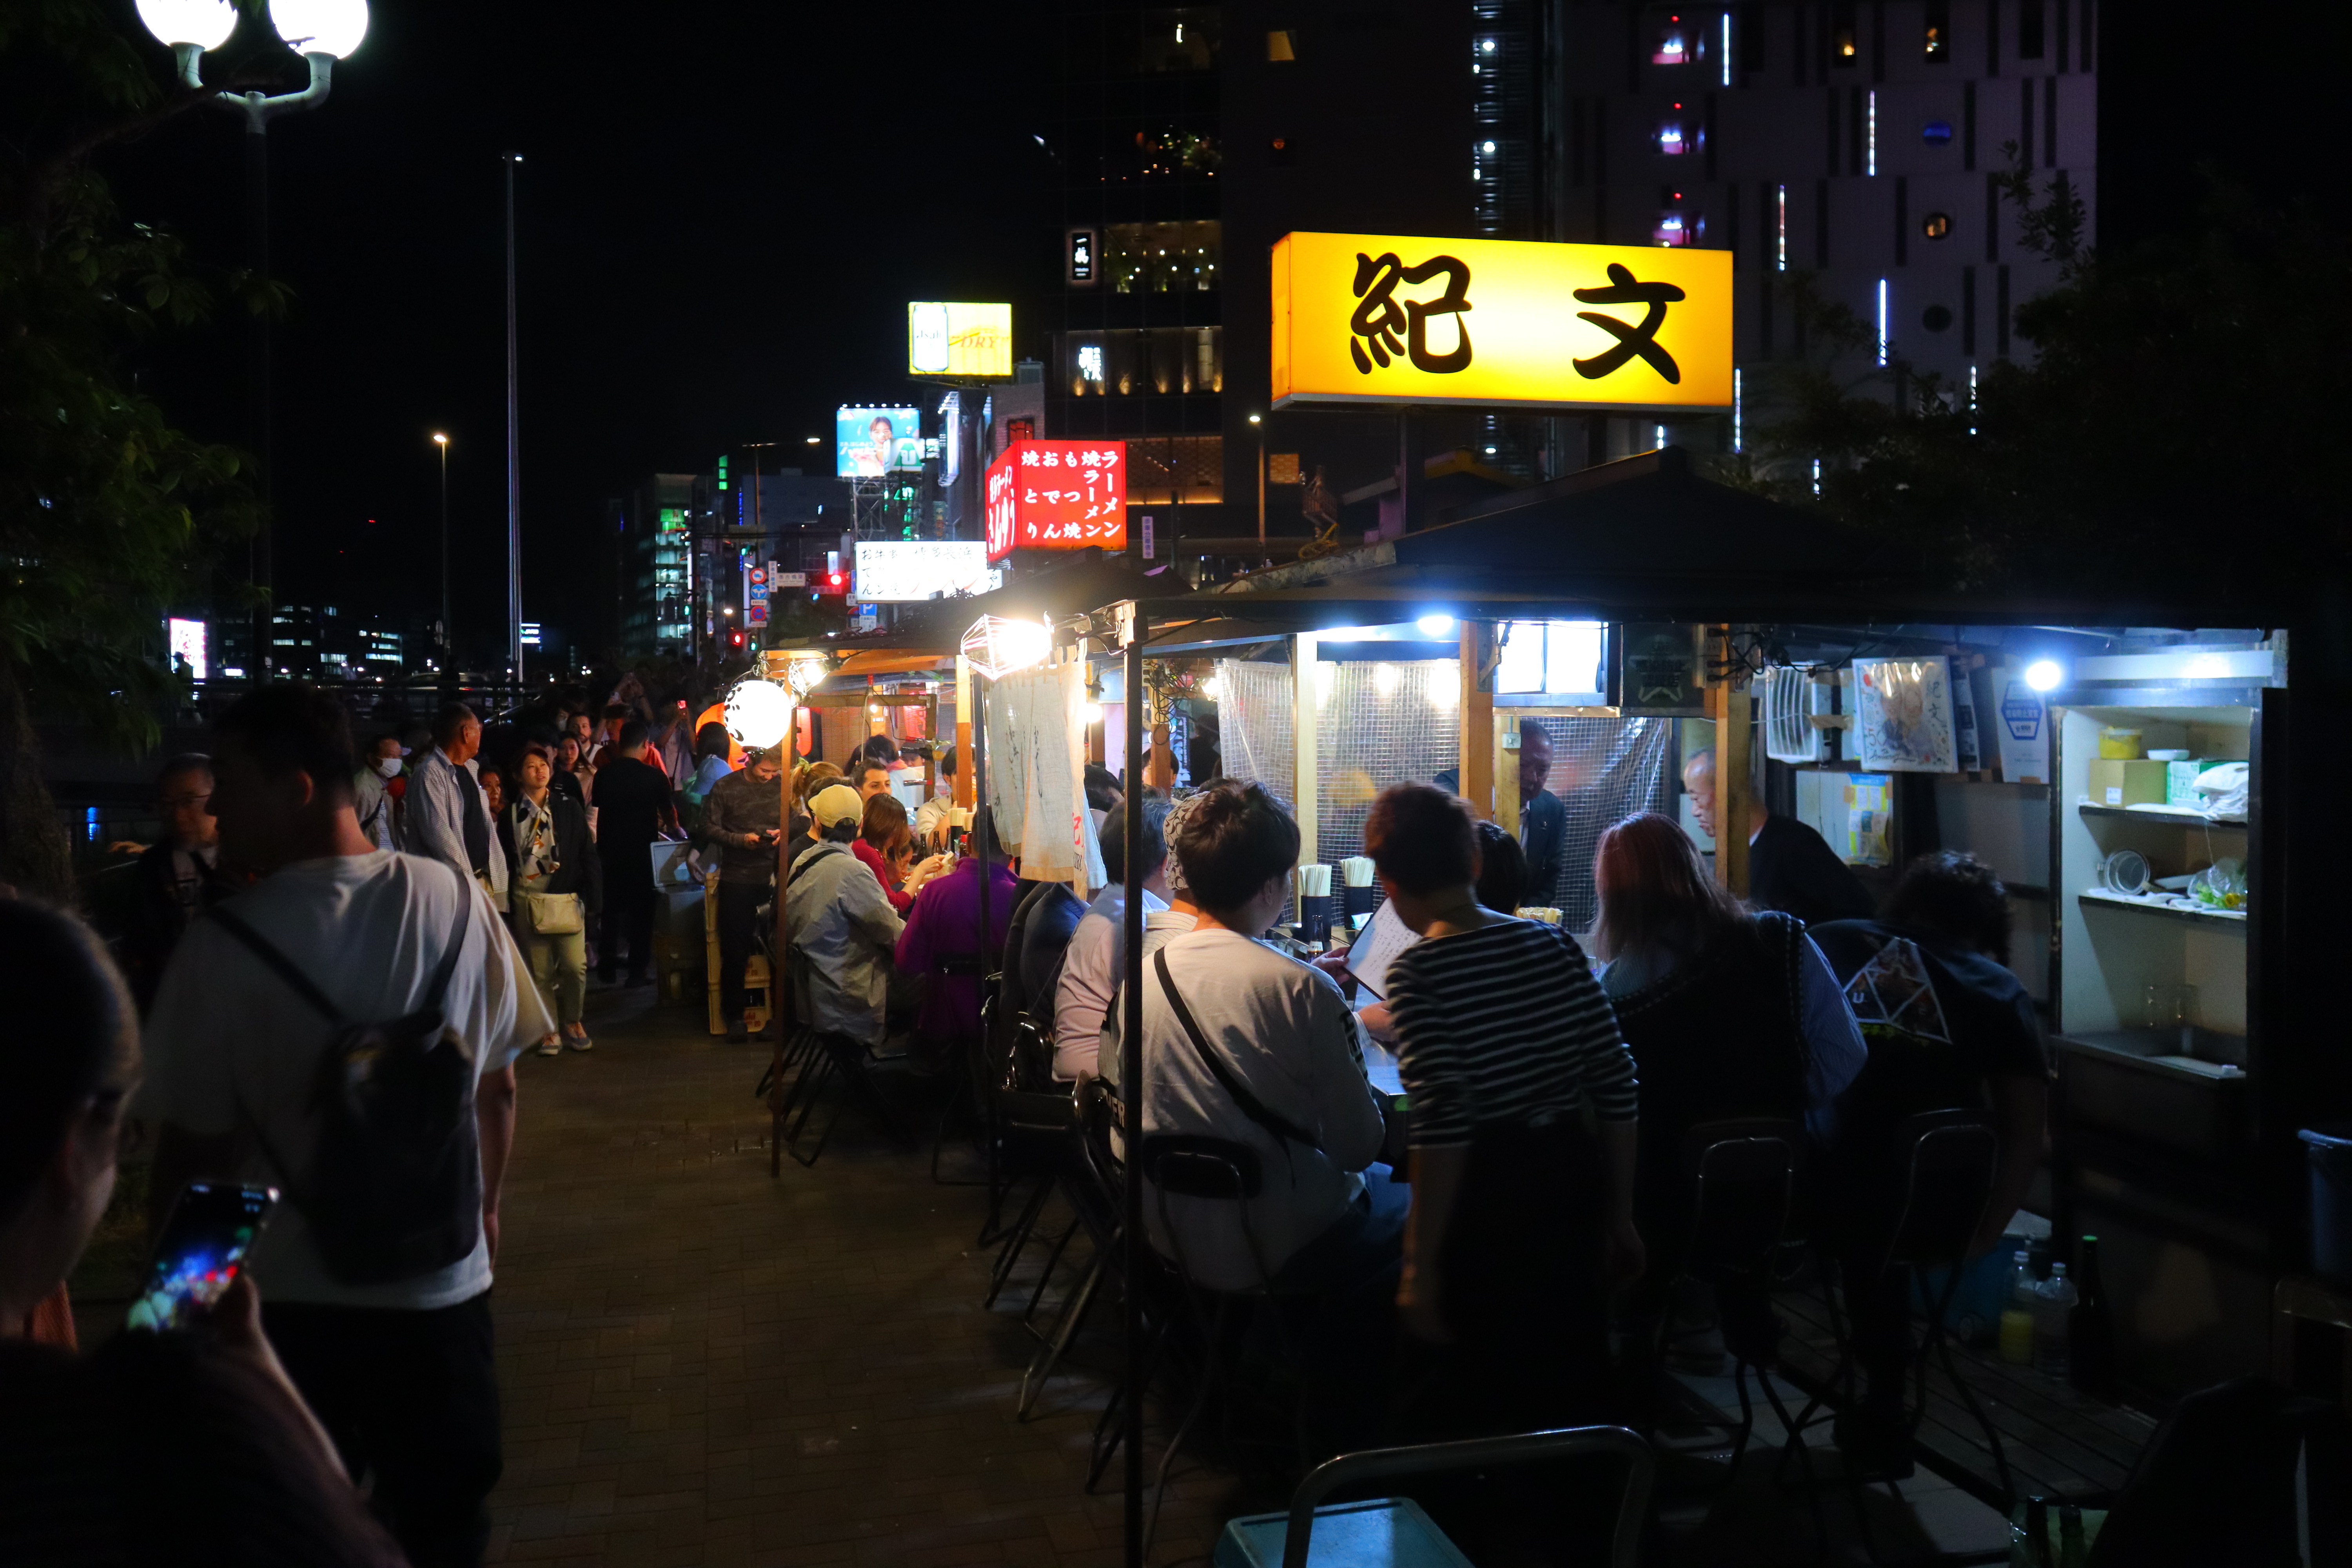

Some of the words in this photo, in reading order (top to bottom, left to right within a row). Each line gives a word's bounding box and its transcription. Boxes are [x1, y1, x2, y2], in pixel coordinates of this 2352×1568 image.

[1350, 252, 1686, 385] 紀文
[1021, 450, 1040, 539] 焼とり
[1042, 451, 1061, 539] おでん
[1063, 451, 1082, 539] もつ焼
[1081, 450, 1102, 537] 焼ラーメン
[1101, 450, 1121, 537] ラーメン
